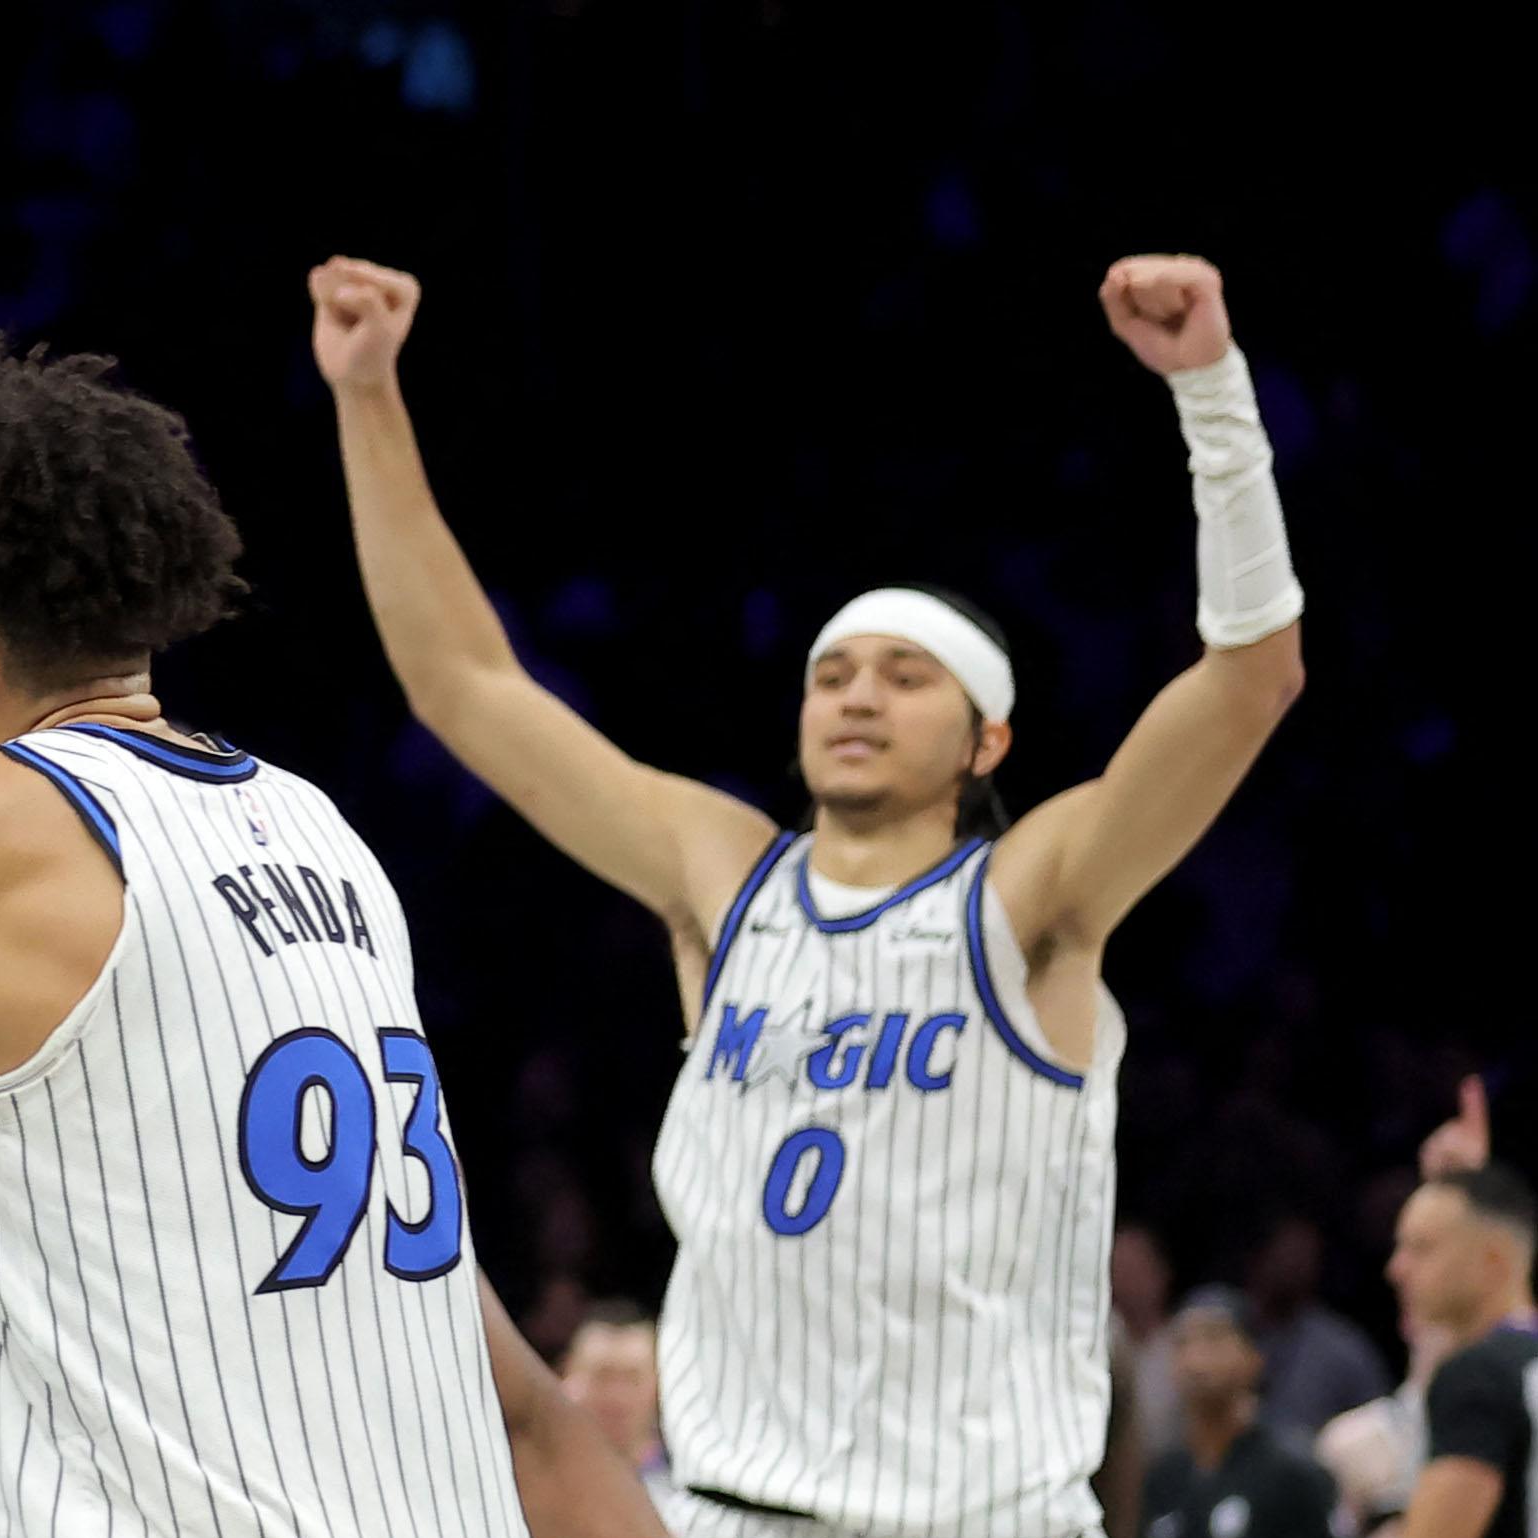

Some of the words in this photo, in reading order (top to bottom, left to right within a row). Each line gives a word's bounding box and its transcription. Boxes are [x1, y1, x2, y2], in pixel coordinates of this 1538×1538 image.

[212, 863, 379, 960] PENDA
[237, 1026, 463, 1296] 93
[762, 1126, 846, 1237] 0
